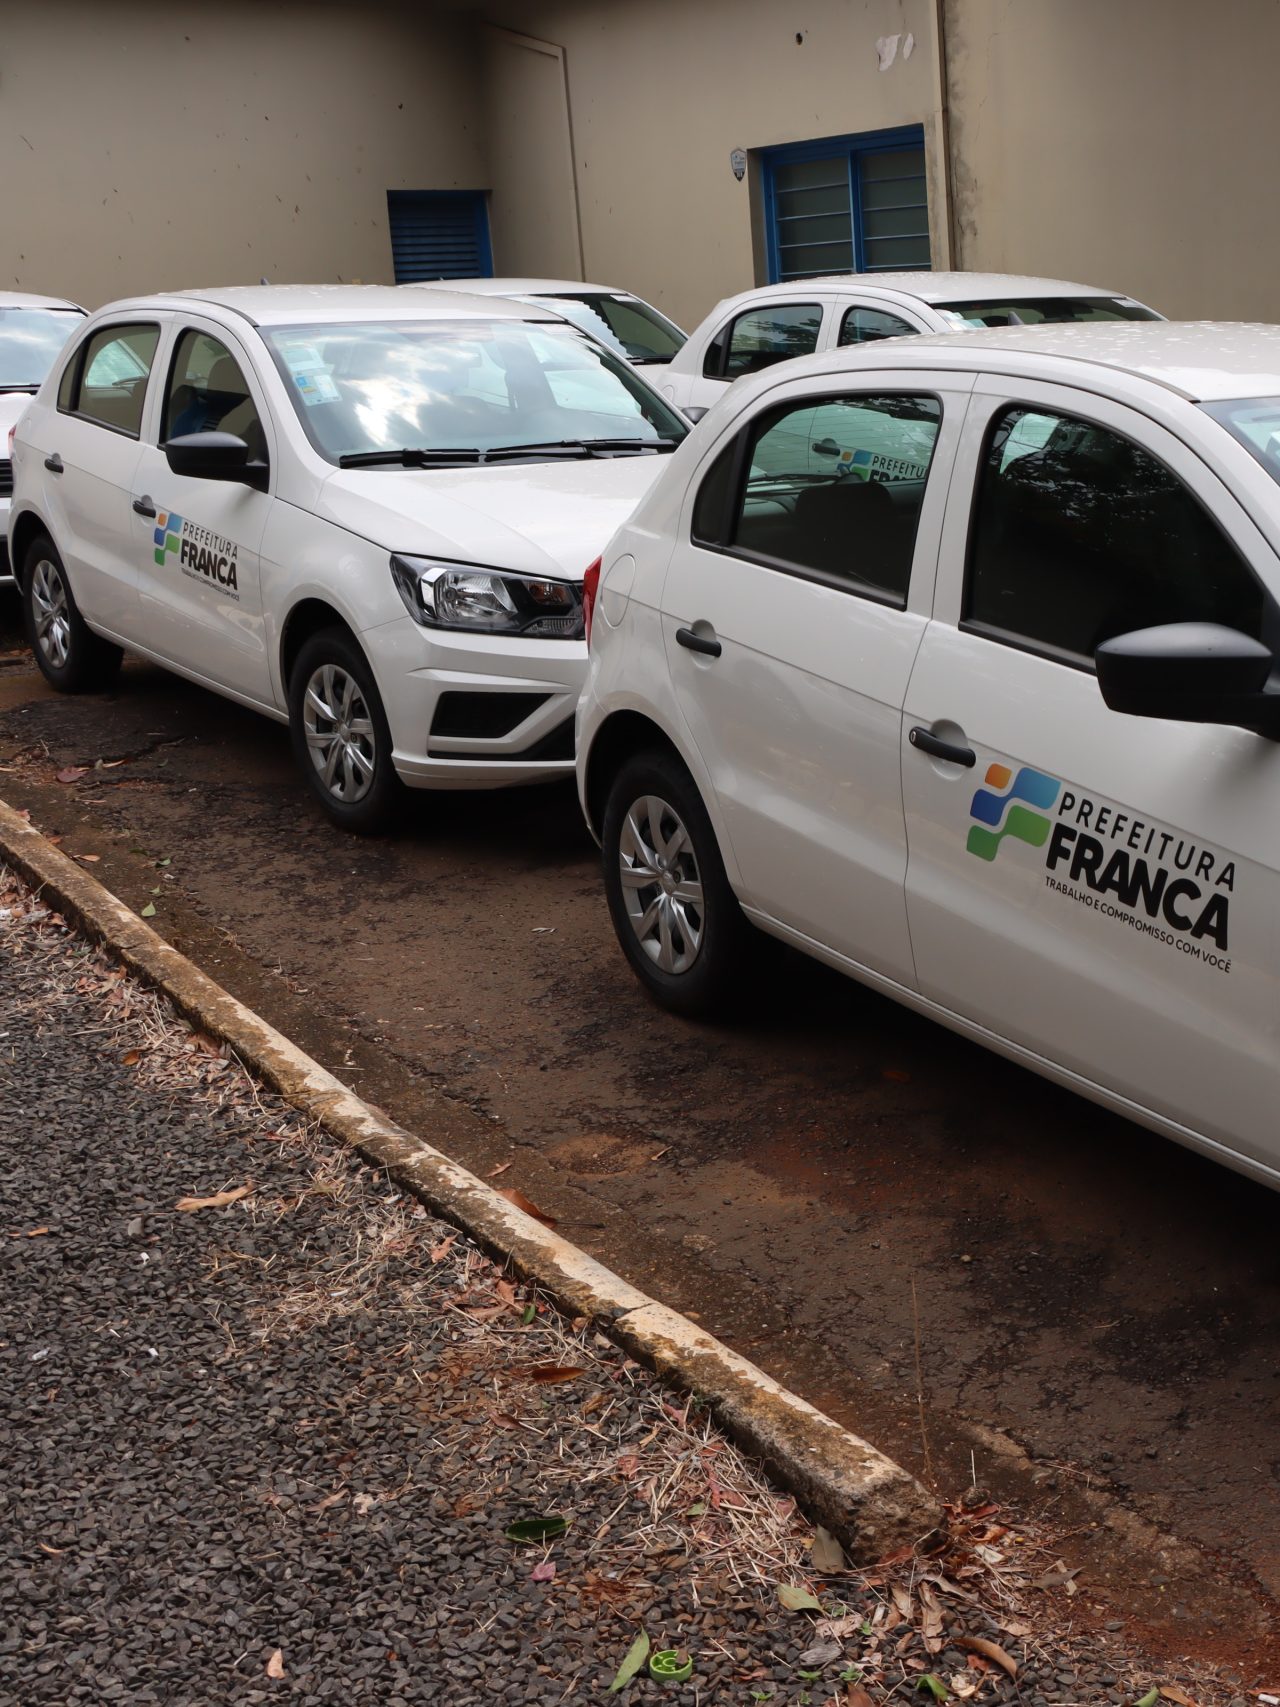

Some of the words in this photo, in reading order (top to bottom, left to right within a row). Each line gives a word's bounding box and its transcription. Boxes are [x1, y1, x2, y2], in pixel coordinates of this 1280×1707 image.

[871, 455, 926, 478] PREFEITU
[181, 538, 238, 590] FRANCA
[182, 521, 238, 560] PREFEITURA
[1058, 791, 1236, 892] PREFEITURA
[1046, 822, 1229, 951] FRANCA
[1045, 875, 1093, 906] TRABALHO
[1100, 903, 1174, 945] COMPROMISSO
[1175, 939, 1201, 959] COM
[1201, 950, 1232, 974] VOCÊ
